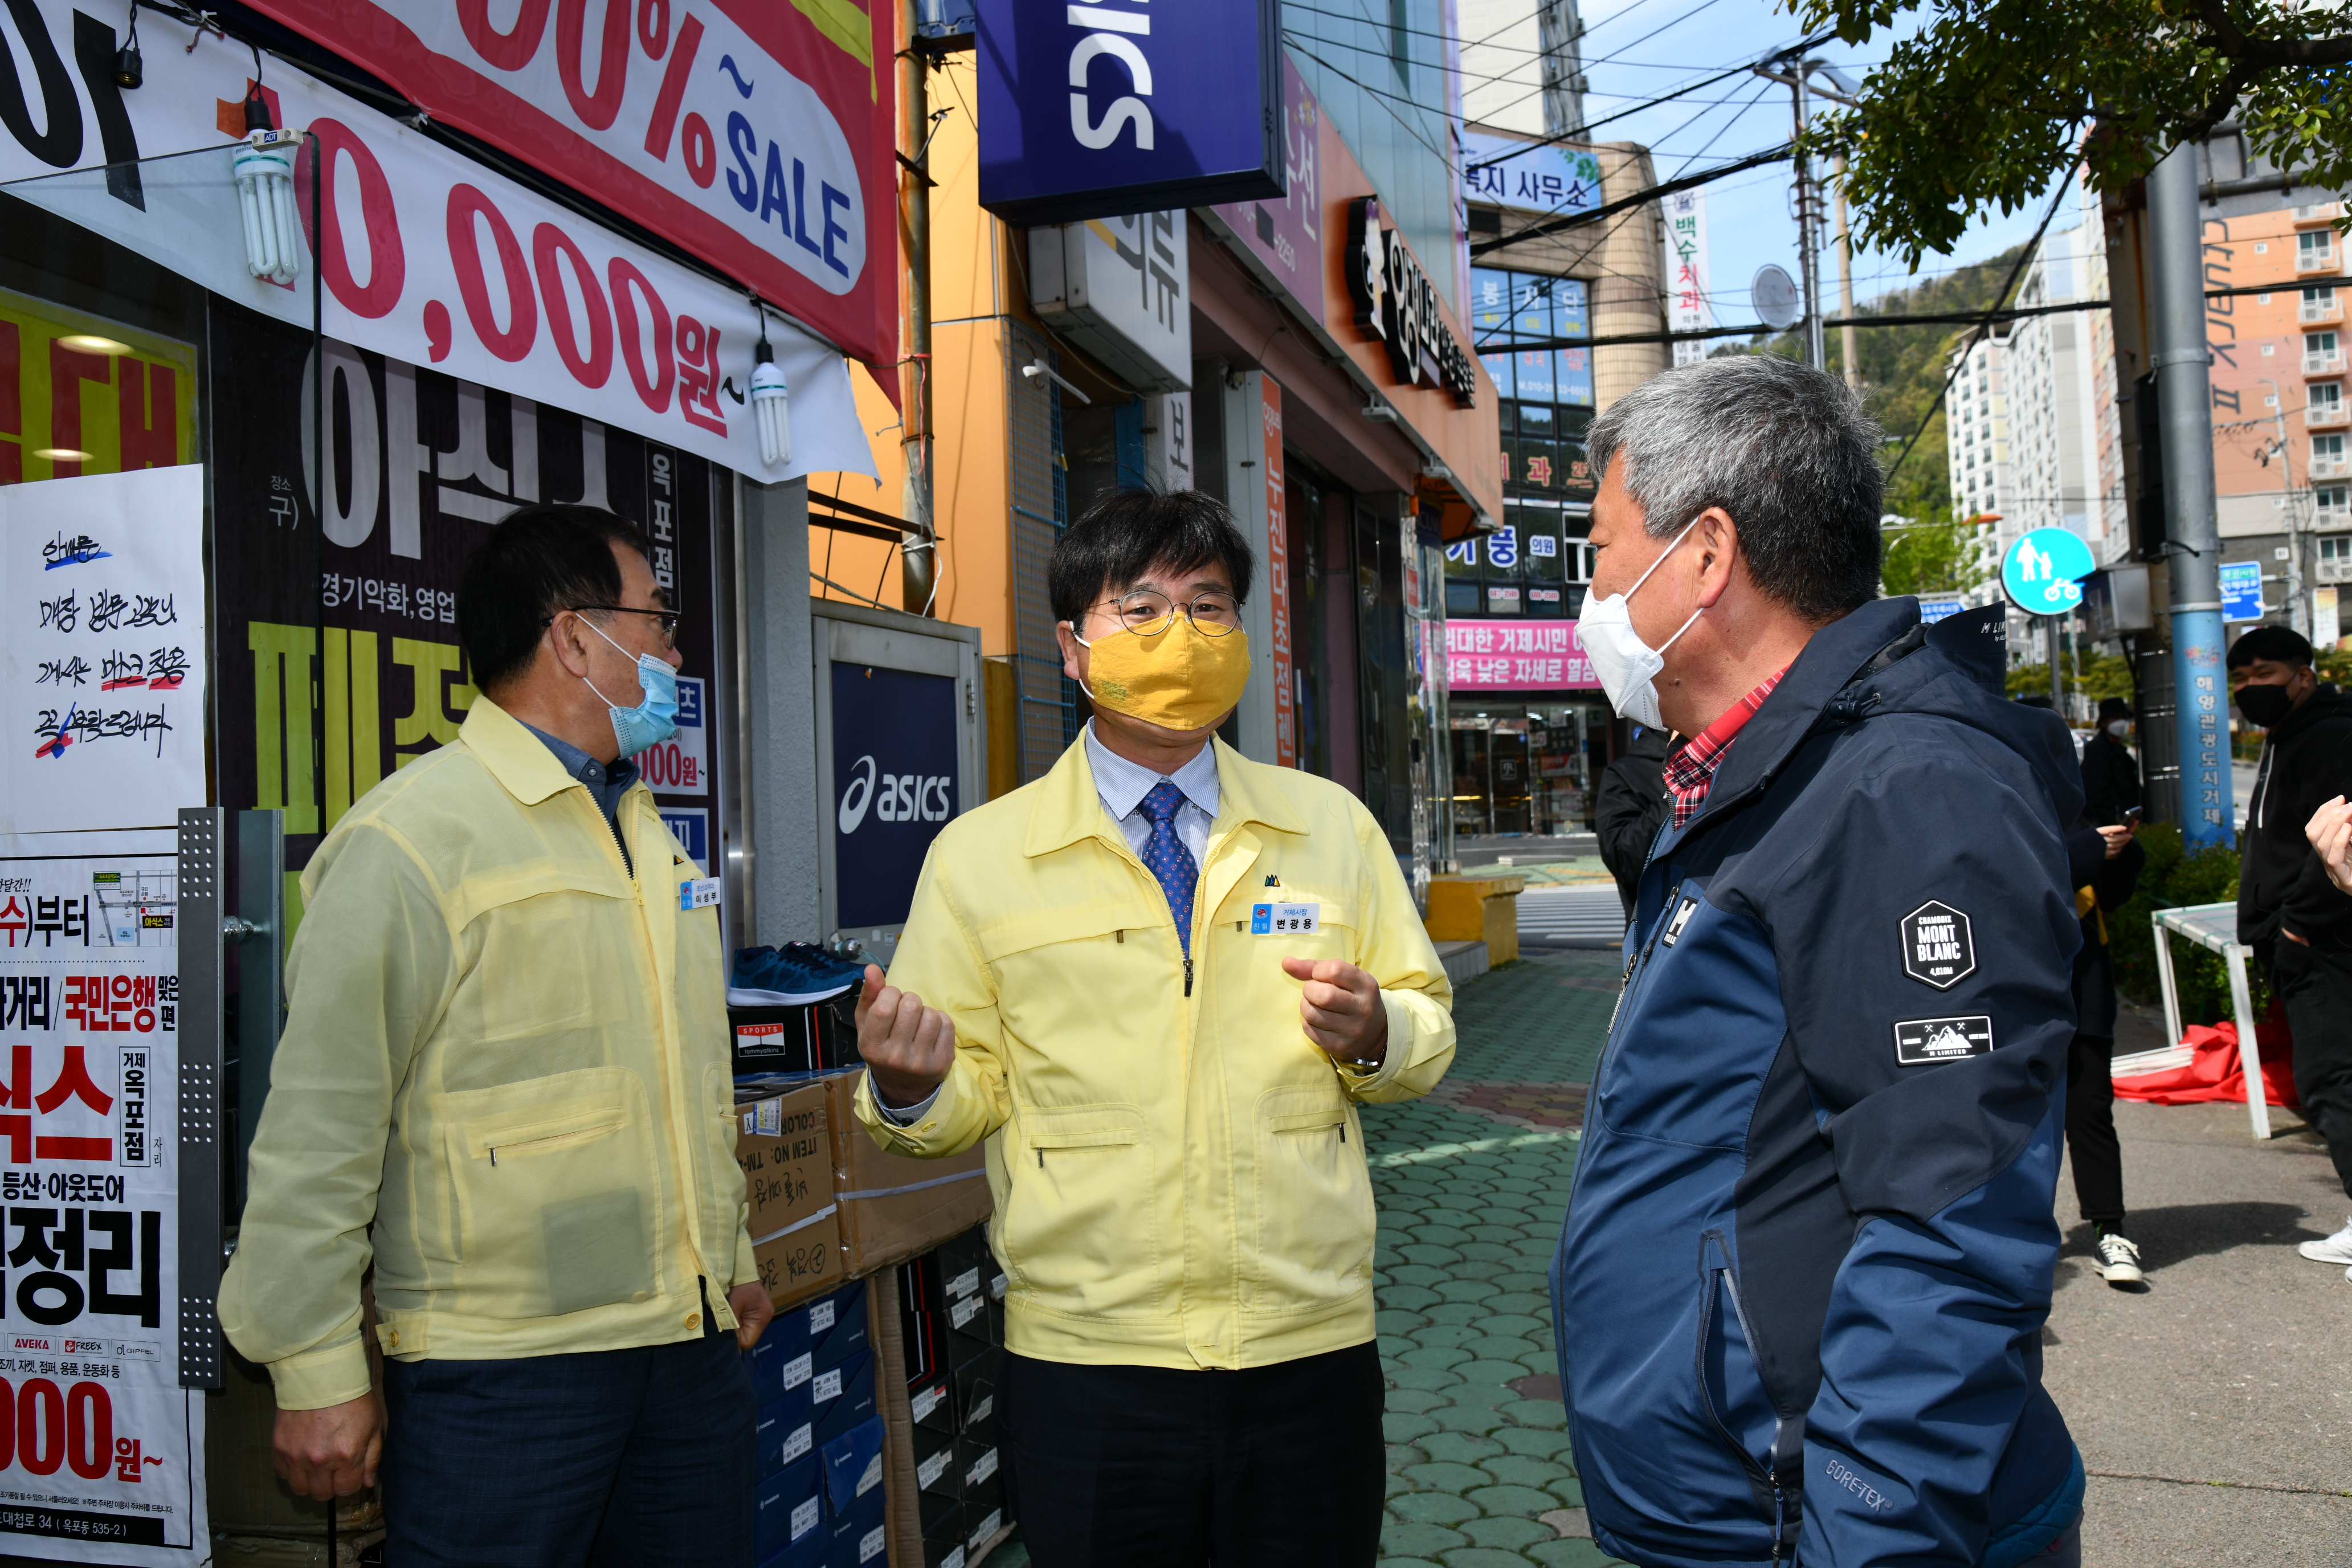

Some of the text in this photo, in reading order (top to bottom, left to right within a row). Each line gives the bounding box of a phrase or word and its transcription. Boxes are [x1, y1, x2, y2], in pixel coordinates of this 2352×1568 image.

[264, 131, 277, 142] ADT
[726, 111, 850, 280] SALE
[1517, 171, 1589, 208] 사무소
[1676, 214, 1699, 311] 백수치과
[1528, 457, 1552, 486] 과
[271, 475, 292, 492] 장소
[1532, 538, 1555, 553] 의원
[39, 588, 80, 633] 매장
[89, 589, 129, 633] 방문
[1498, 628, 1567, 654] 거제시민
[1477, 659, 1510, 684] 낮은
[1514, 659, 1562, 683] 자세로
[876, 773, 951, 822] asics
[145, 917, 164, 927] 아식스
[1917, 924, 1955, 944] MONT
[1916, 942, 1962, 962] BLANC
[0, 976, 50, 1031] 거리
[65, 975, 156, 1033] 국민은행
[161, 1006, 175, 1031] 편
[742, 1026, 778, 1035] SPORTS
[123, 1052, 145, 1068] 거제
[124, 1069, 145, 1161] 옥포점
[153, 1136, 163, 1168] 자리
[770, 1144, 790, 1165] NO:
[793, 1137, 817, 1159] ITEM
[0, 1205, 161, 1329] 정리
[14, 1338, 50, 1350] AVEKA
[60, 1362, 80, 1377] 용품,
[82, 1363, 110, 1378] 운동화
[111, 1365, 120, 1379] 등
[32, 1493, 48, 1503] 있으니
[98, 1499, 115, 1509] 주차장
[115, 1501, 130, 1510] 이용시
[151, 1505, 174, 1514] 드립니다.
[38, 1514, 52, 1529] 34
[62, 1518, 90, 1535] 옥포동
[92, 1522, 121, 1536] 535-2
